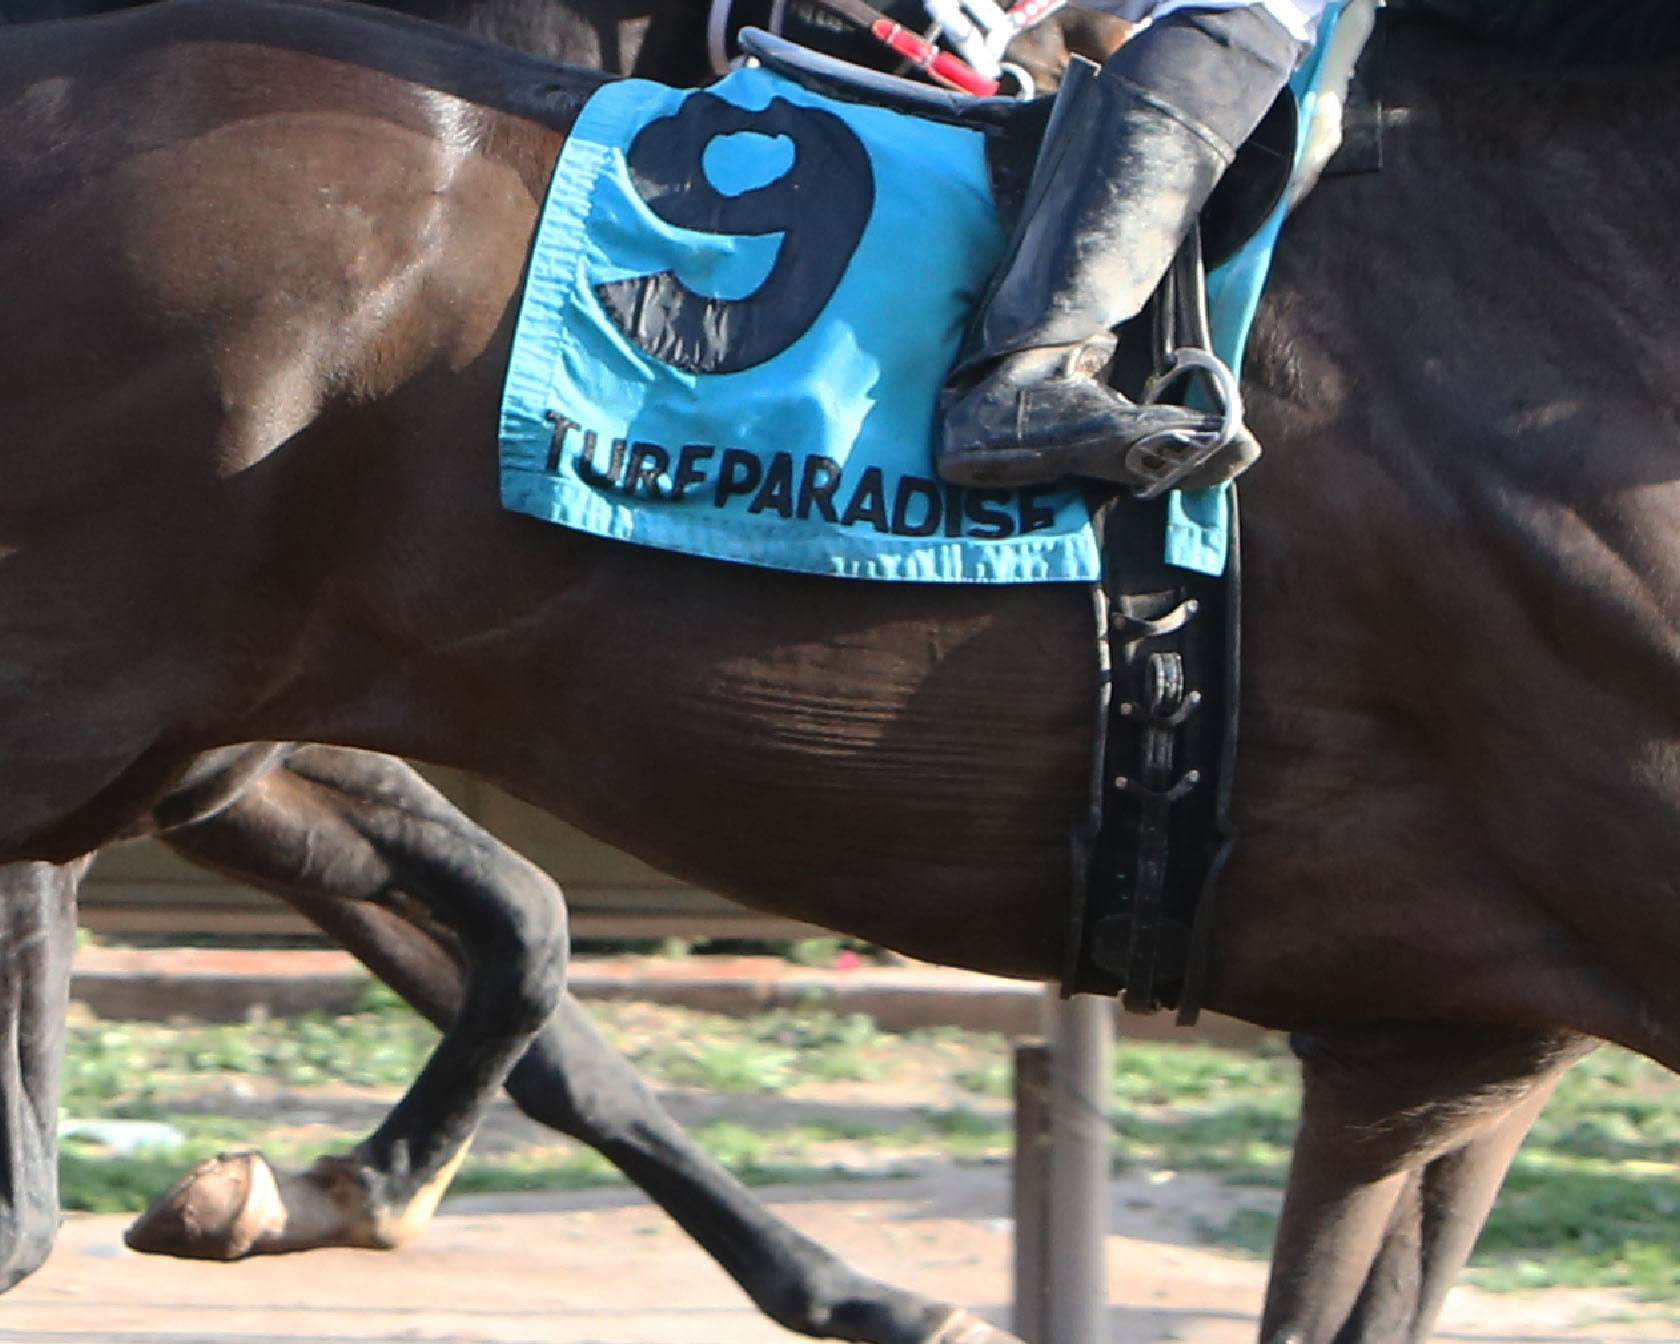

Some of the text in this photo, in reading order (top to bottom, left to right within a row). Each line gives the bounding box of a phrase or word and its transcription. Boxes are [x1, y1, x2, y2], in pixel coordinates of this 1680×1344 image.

[595, 91, 876, 376] 9
[545, 409, 1055, 539] TURF PARADISE
